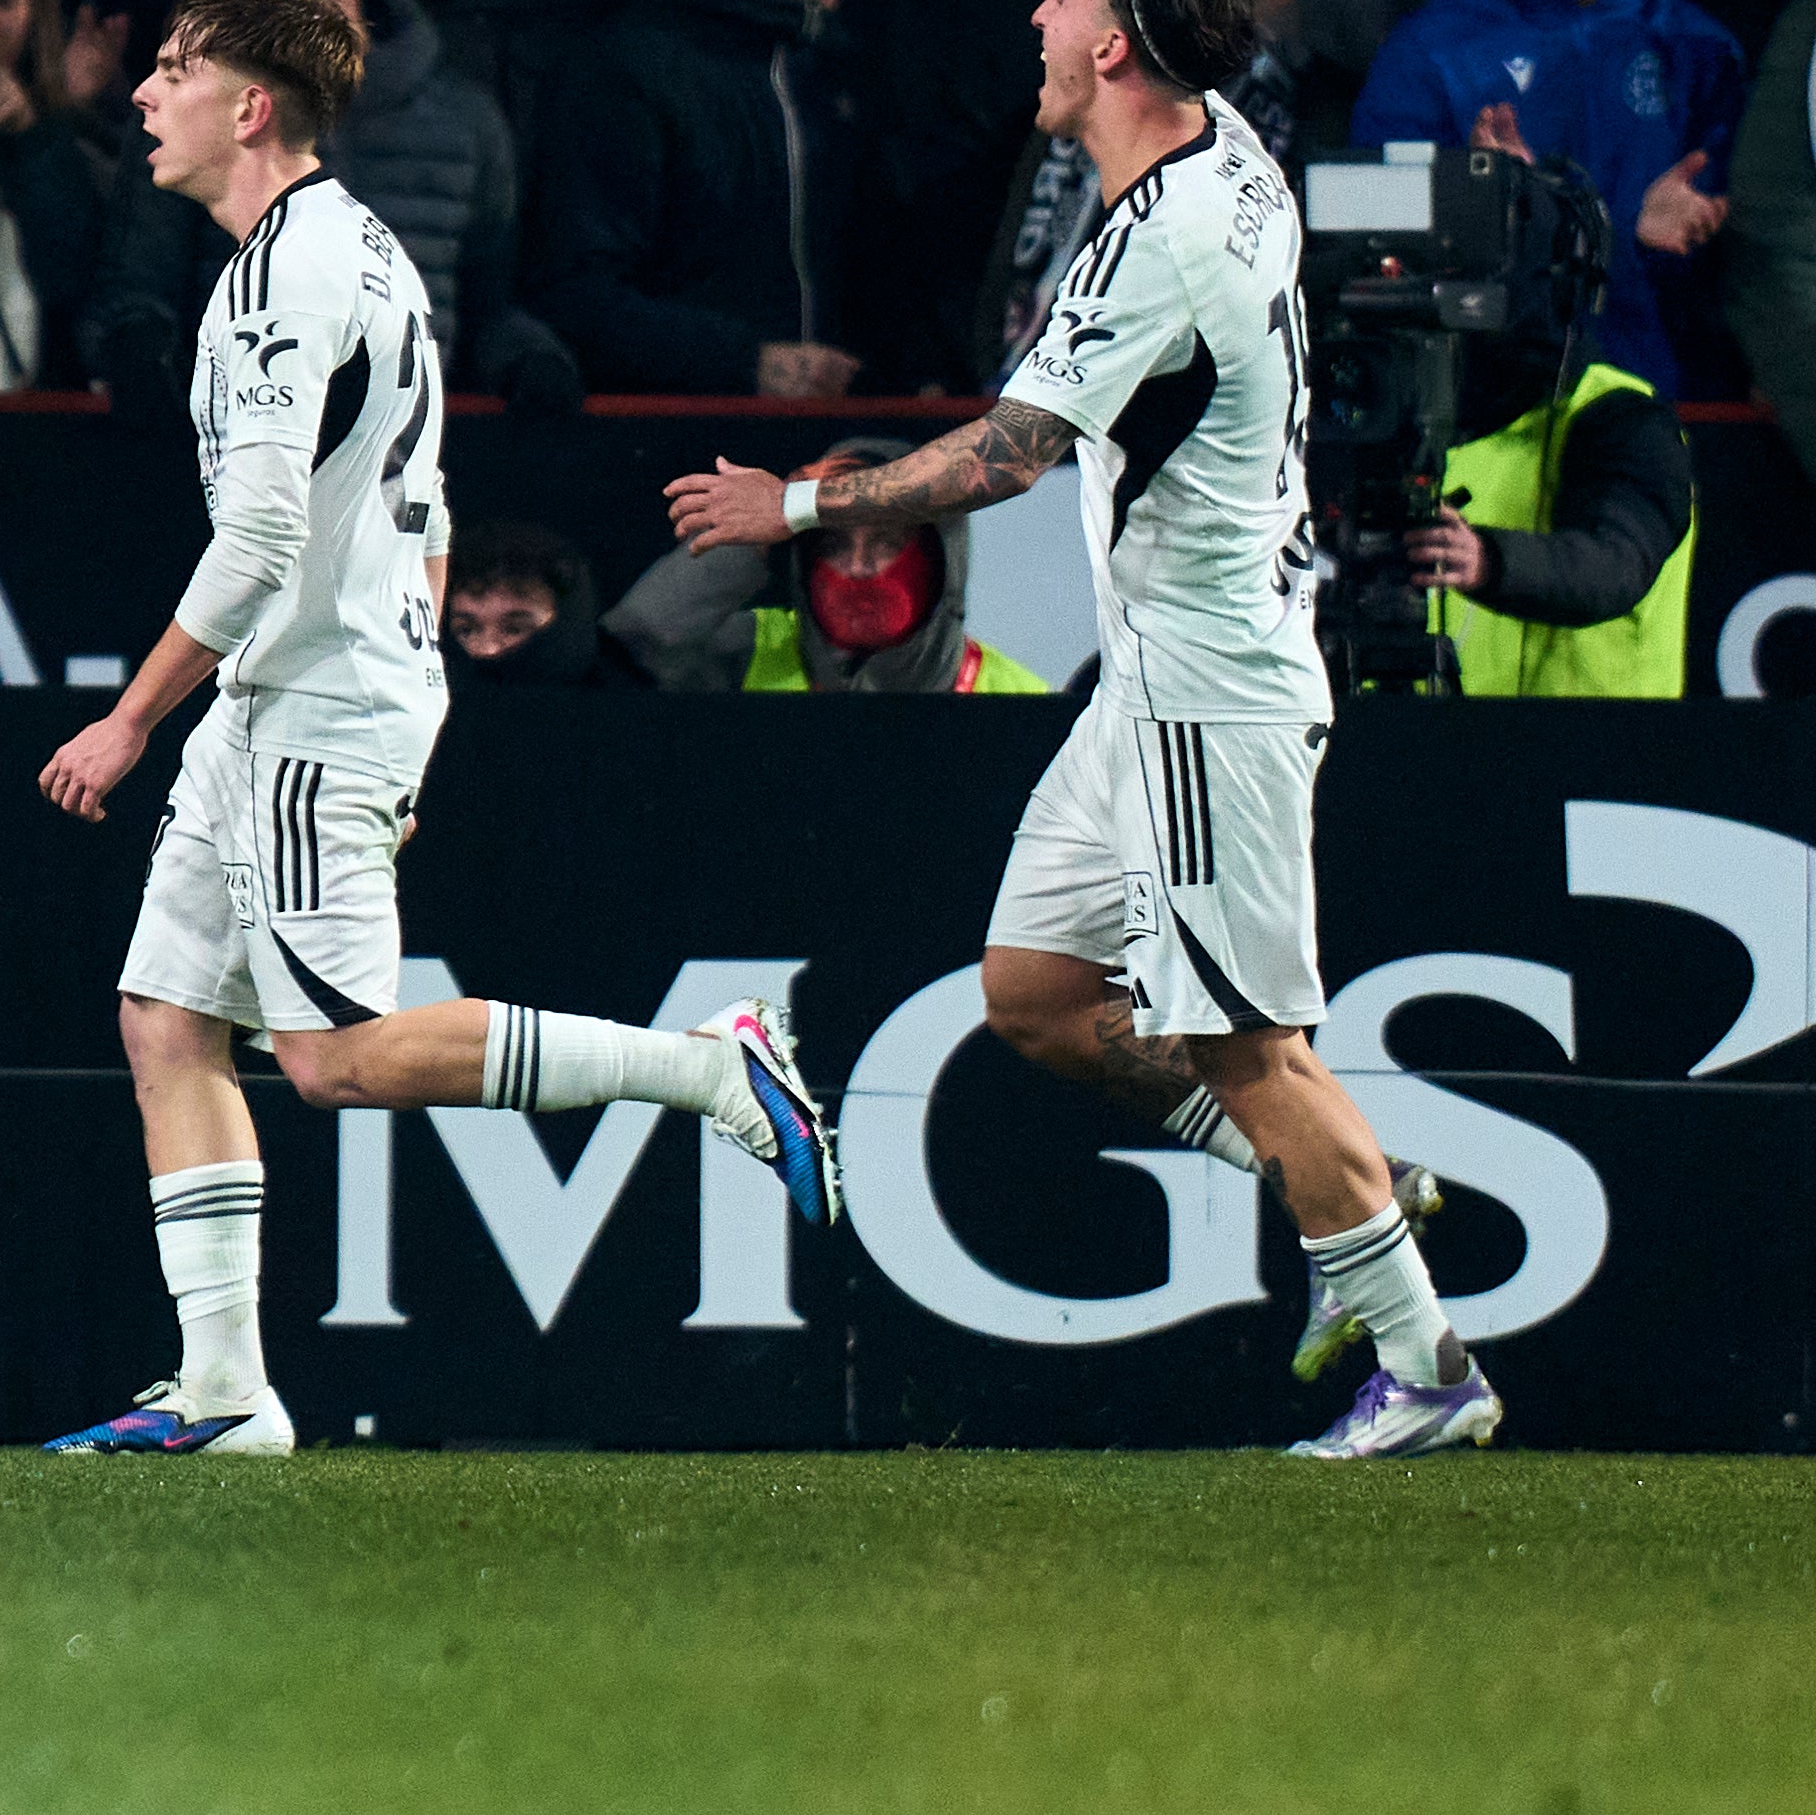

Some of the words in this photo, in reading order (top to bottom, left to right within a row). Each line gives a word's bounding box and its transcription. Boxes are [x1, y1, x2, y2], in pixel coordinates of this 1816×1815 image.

[1026, 350, 1088, 385] MGS
[236, 383, 294, 411] MGS
[318, 951, 1610, 1347] MGS
